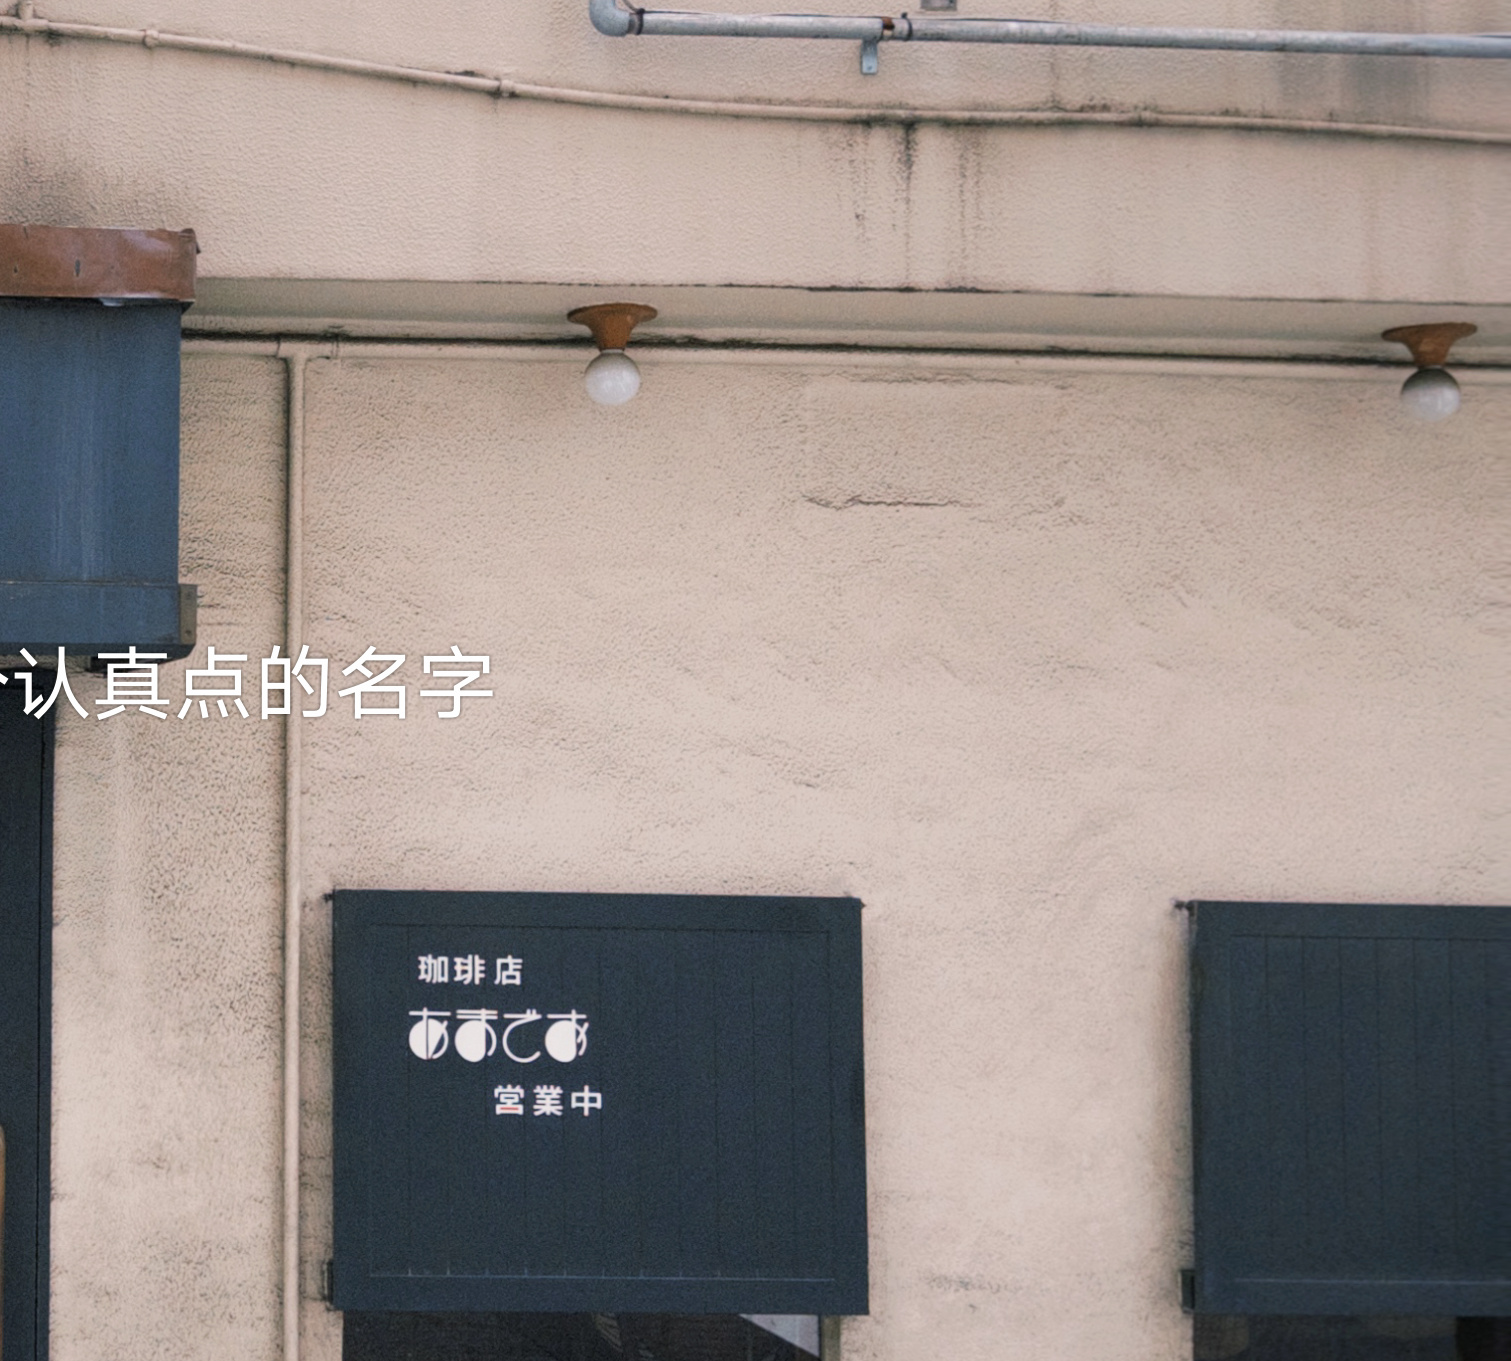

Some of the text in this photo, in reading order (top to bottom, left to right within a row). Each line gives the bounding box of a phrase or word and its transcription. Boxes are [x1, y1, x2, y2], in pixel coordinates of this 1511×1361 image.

[418, 955, 523, 986] 珈琲店
[494, 1084, 603, 1117] 営業中
